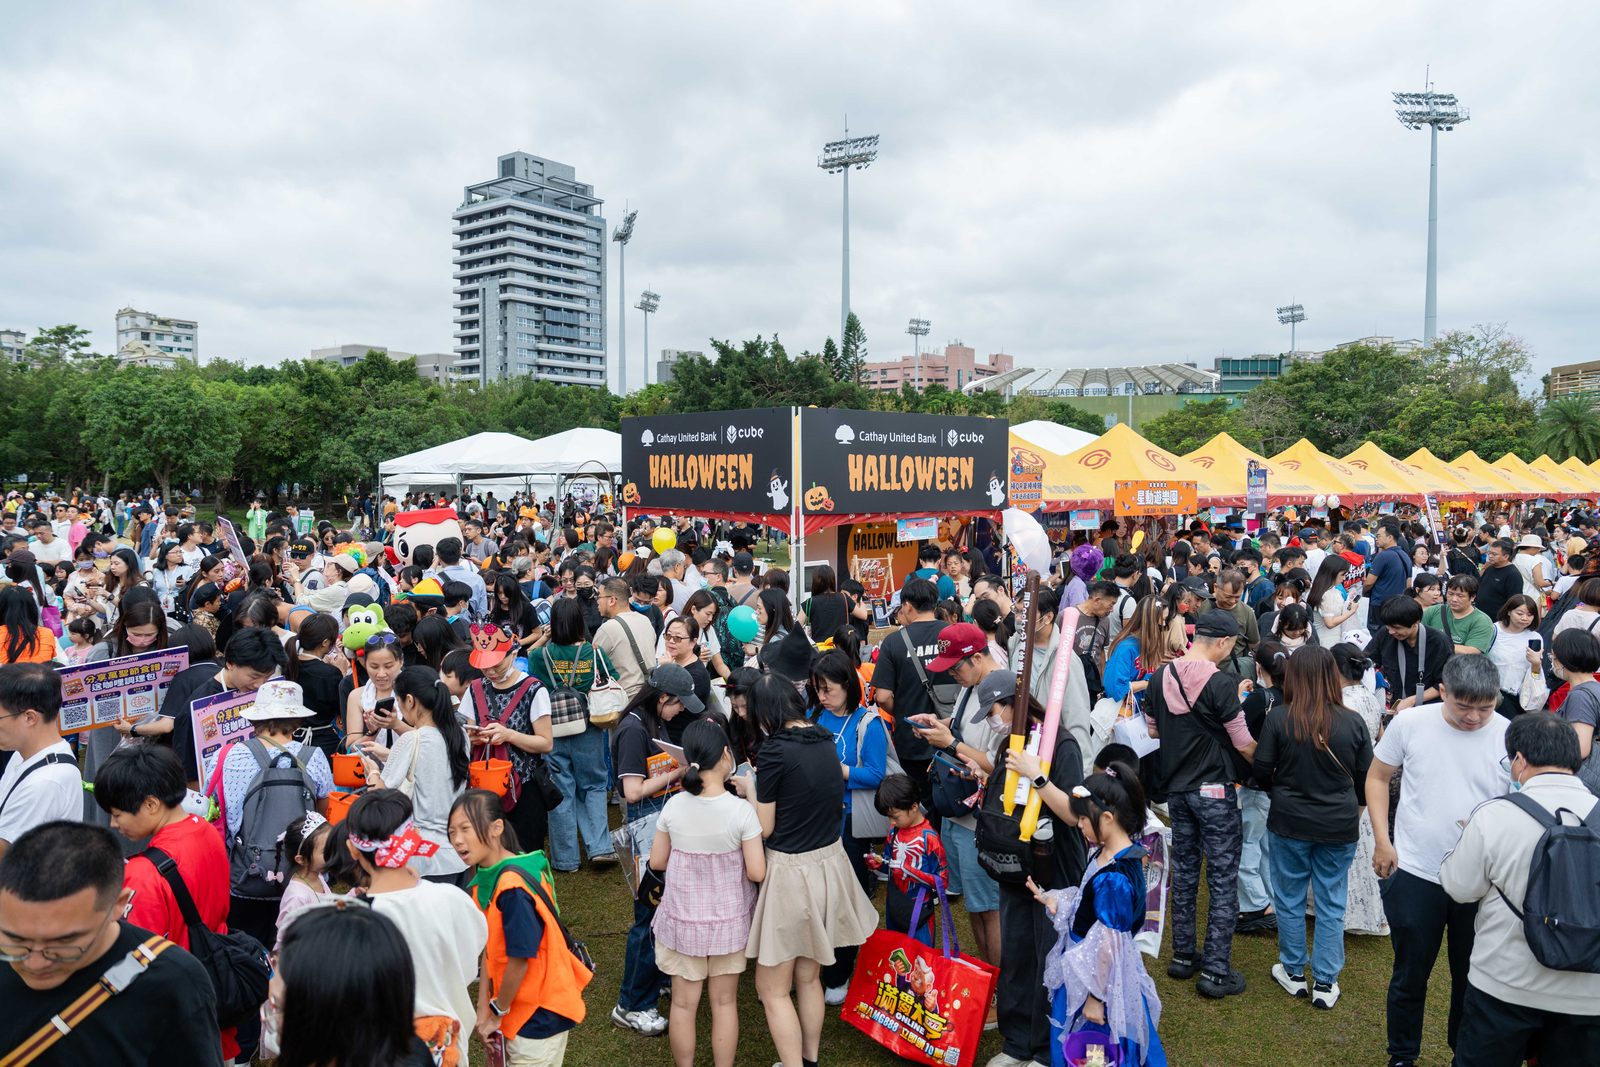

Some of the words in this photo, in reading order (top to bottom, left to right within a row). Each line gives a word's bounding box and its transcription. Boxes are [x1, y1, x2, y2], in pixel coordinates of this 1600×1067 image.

[656, 433, 678, 445] Cathay
[678, 432, 699, 442] United
[700, 431, 717, 442] Bank
[738, 425, 764, 439] cube
[859, 430, 888, 444] Cathay
[889, 432, 916, 443] United
[917, 434, 937, 444] Bank
[959, 432, 985, 444] cube
[649, 453, 753, 491] HALLOWEEN
[847, 453, 974, 493] HALLOWEEN
[1137, 489, 1178, 506] 星動遊樂園
[85, 662, 162, 685] 分享萬聖節食譜
[91, 672, 157, 692] 送咖哩調理包
[895, 1012, 926, 1036] ONLINE
